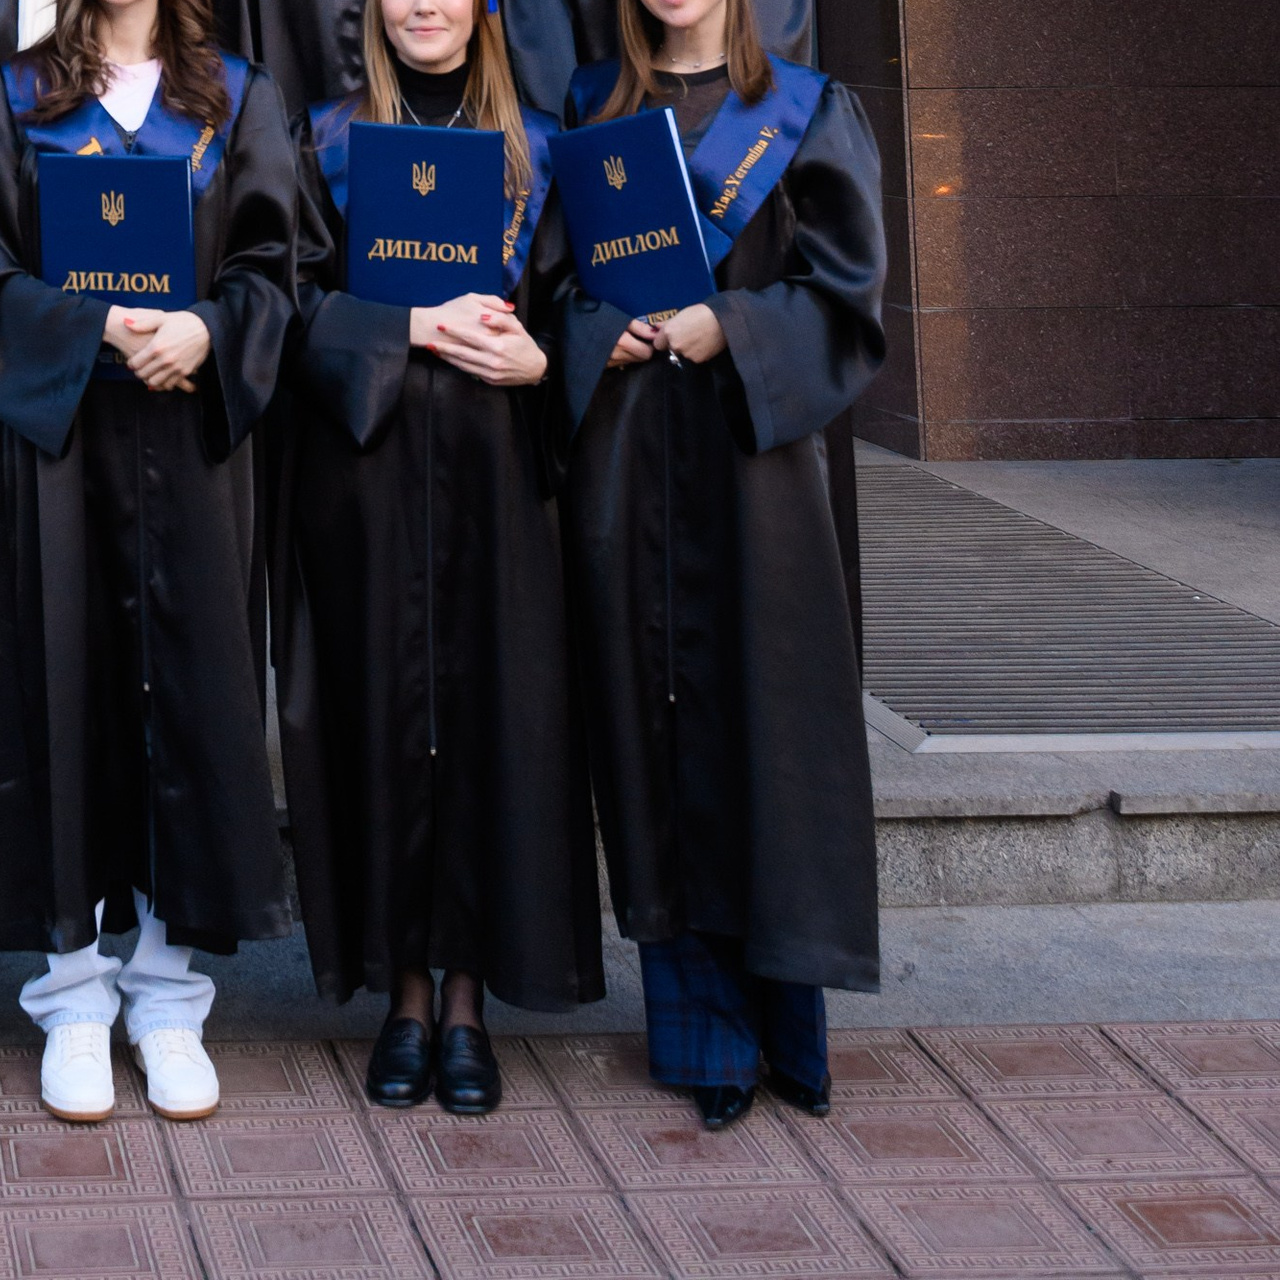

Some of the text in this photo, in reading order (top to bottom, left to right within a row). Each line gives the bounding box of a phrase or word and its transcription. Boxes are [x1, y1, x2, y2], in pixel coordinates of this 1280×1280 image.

[367, 238, 478, 265] ДИПЛОМ
[591, 226, 680, 267] ДИПЛОМ
[61, 271, 171, 293] ДИПЛОМ
